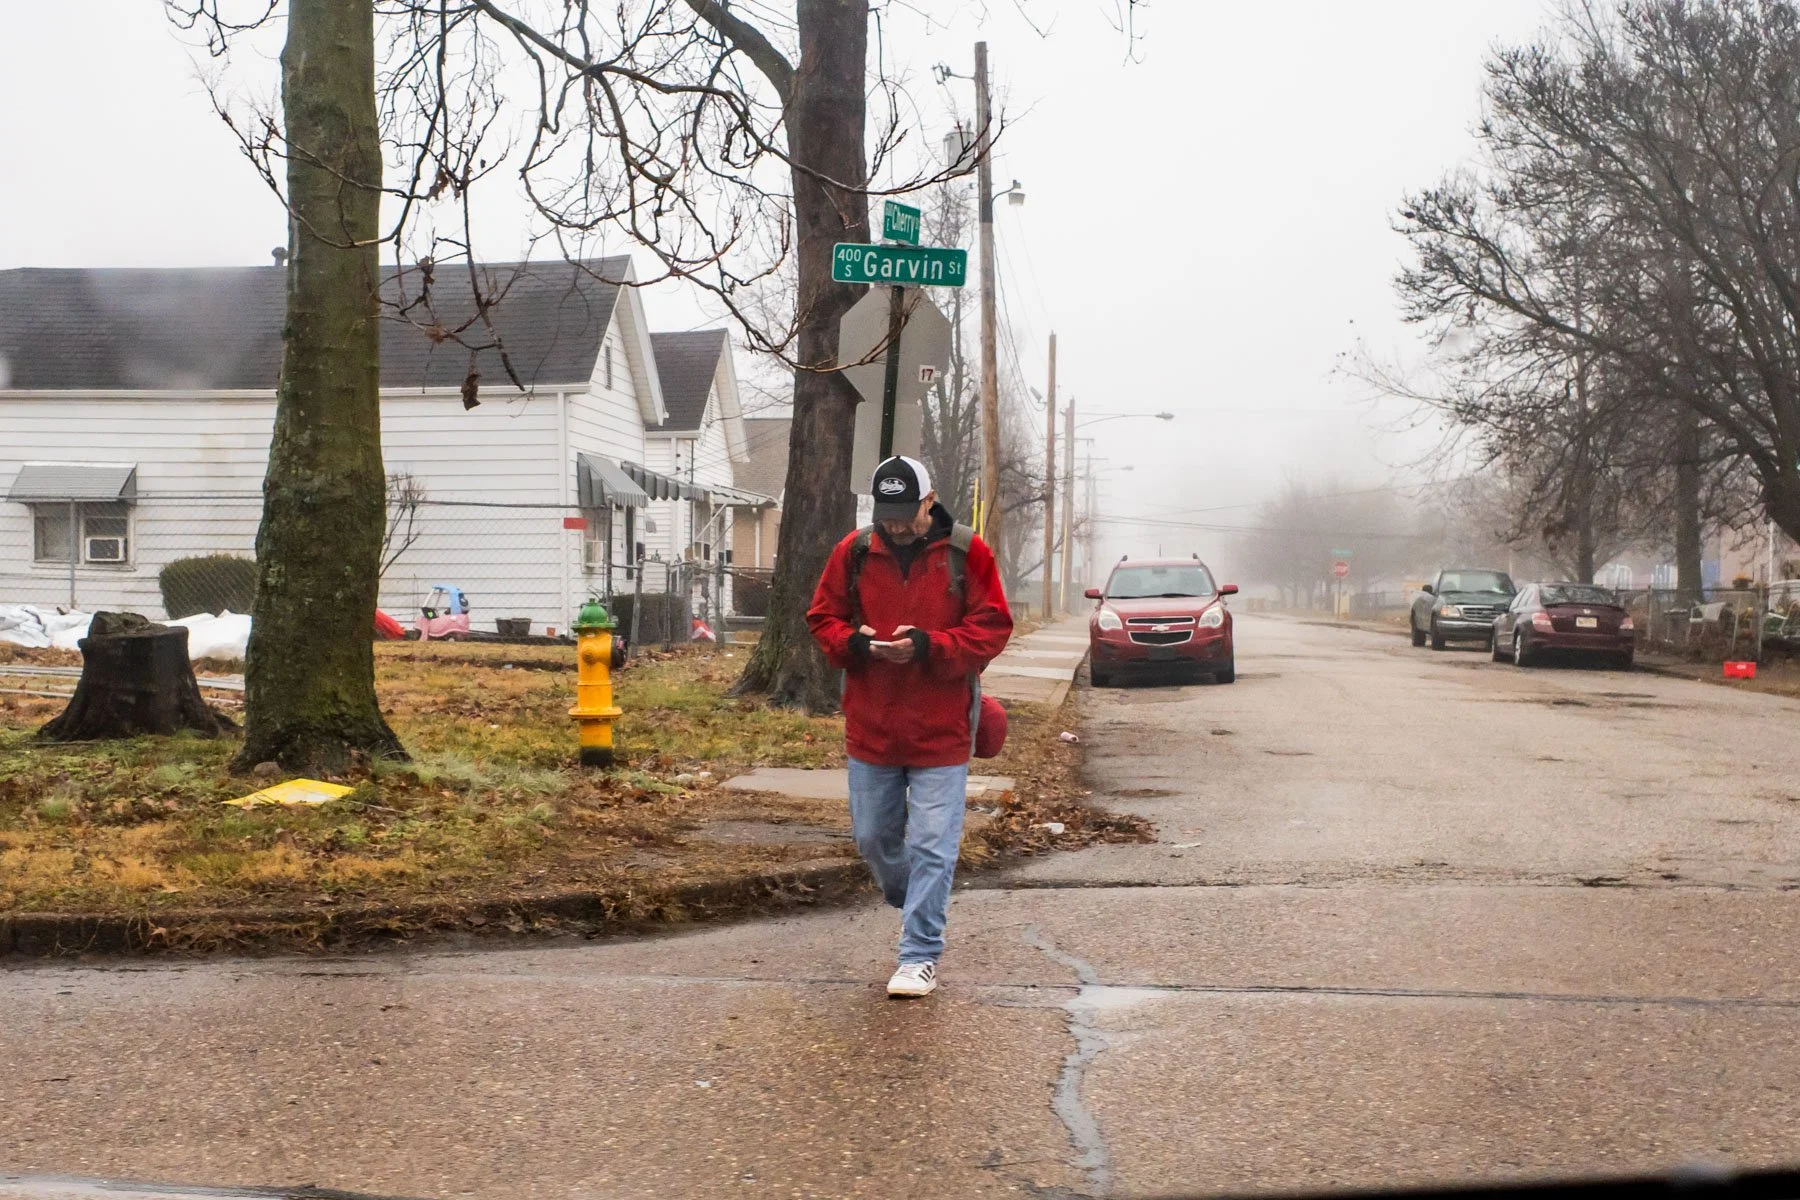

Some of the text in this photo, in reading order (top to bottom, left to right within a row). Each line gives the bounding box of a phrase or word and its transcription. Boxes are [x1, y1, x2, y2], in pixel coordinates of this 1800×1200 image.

[892, 204, 915, 241] Cherry
[837, 248, 862, 262] 400
[844, 264, 852, 278] S
[863, 251, 962, 280] Garvin St
[920, 368, 934, 382] 17
